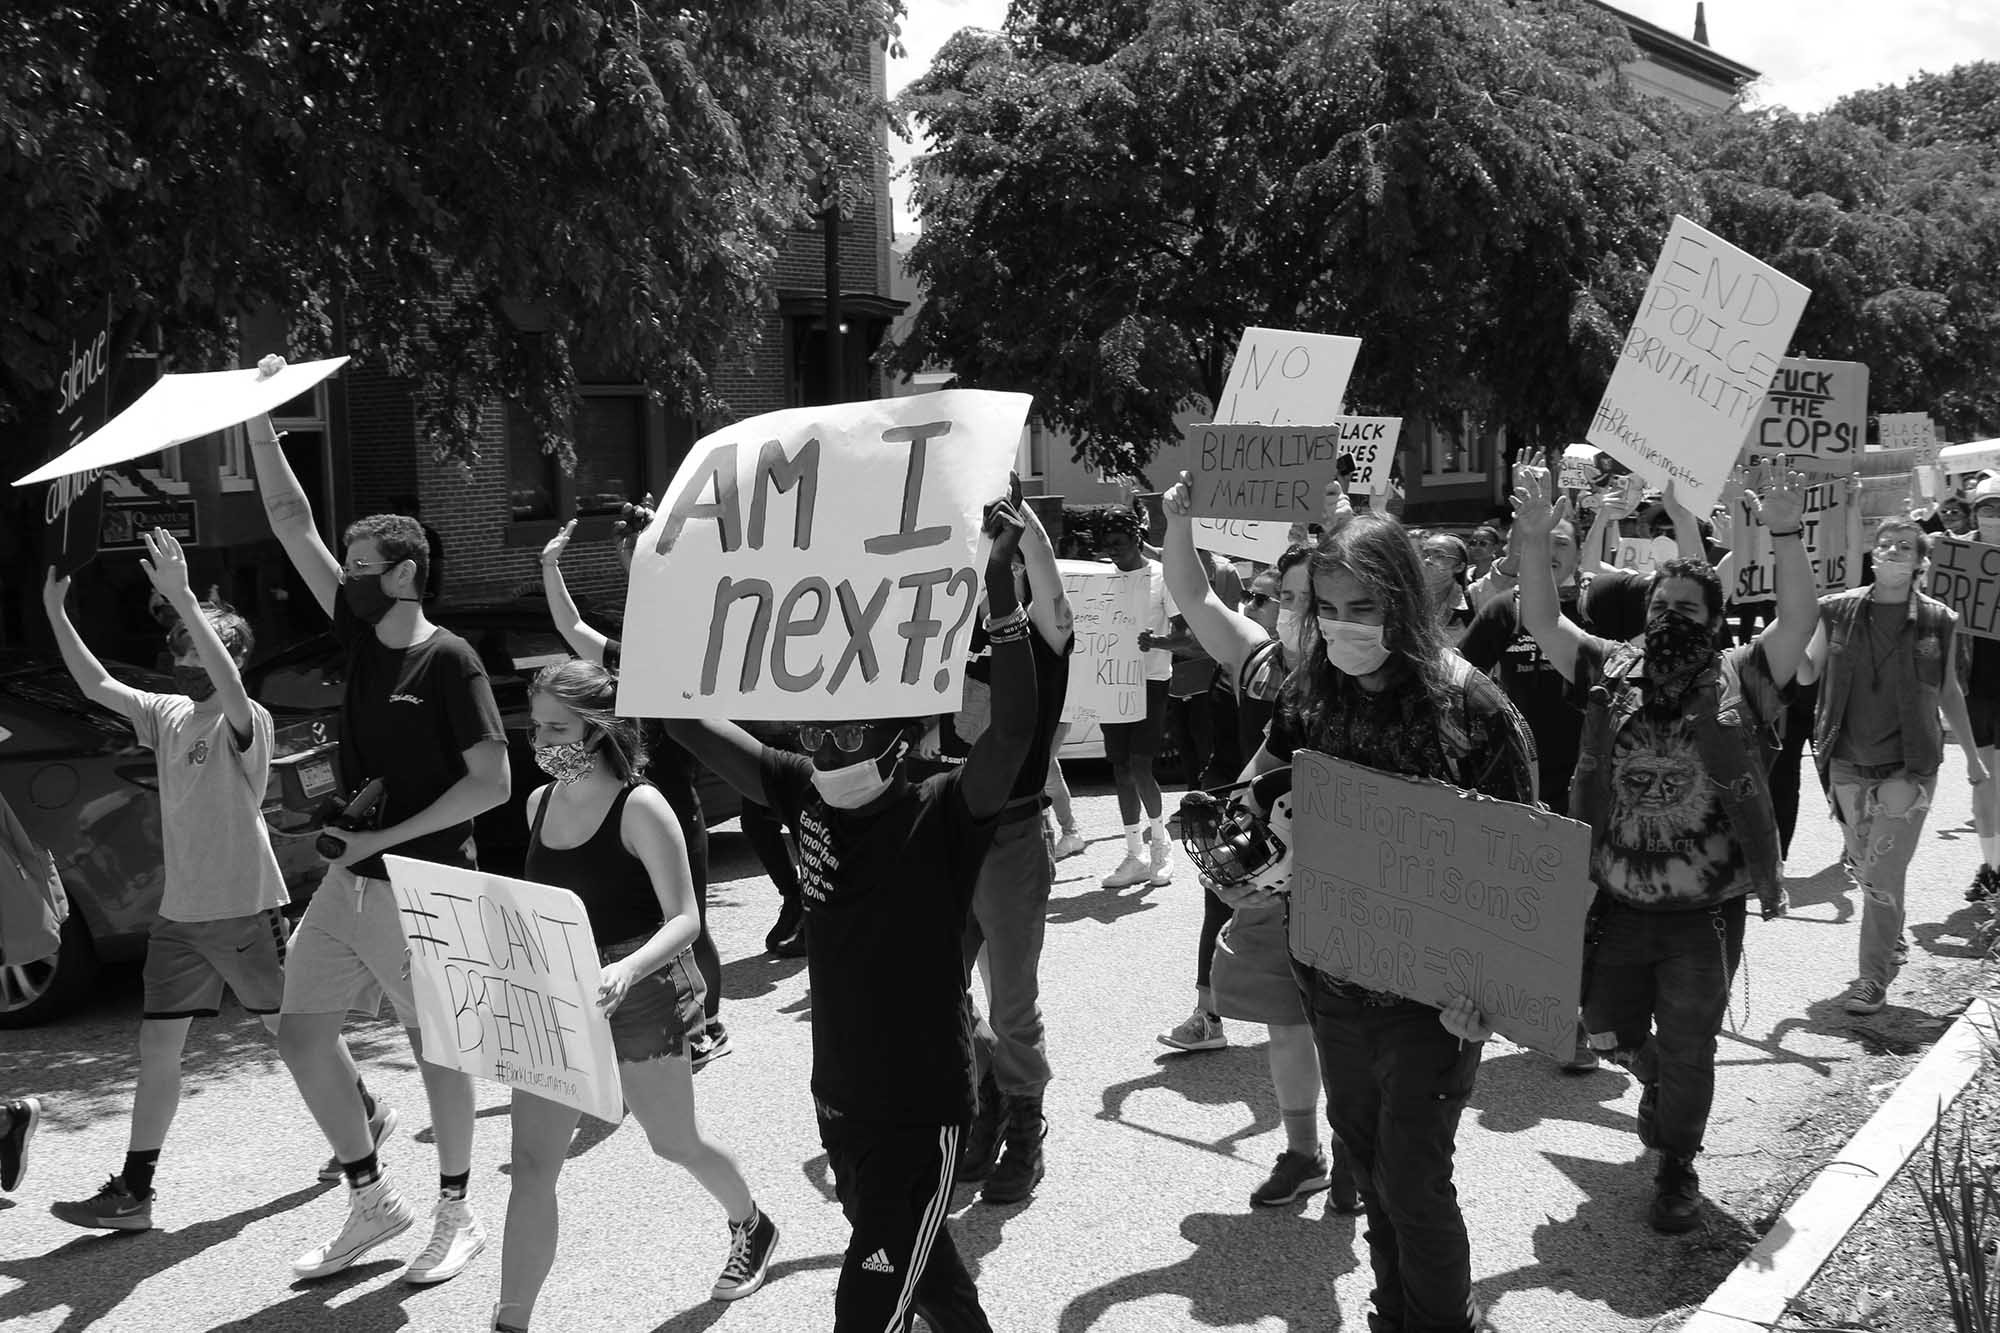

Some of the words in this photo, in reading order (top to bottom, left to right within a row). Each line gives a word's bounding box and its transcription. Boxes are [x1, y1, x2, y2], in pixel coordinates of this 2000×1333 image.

[1663, 236, 1780, 326] END
[1646, 286, 1777, 388] POLICE
[57, 330, 105, 415] silence
[1241, 344, 1310, 391] NO
[1624, 327, 1762, 428] BRUTALITY
[1769, 369, 1834, 395] FUCK
[1771, 398, 1825, 418] THE
[1335, 422, 1385, 440] LACK
[1759, 418, 1858, 454] COPS!
[656, 438, 820, 556] AM
[864, 420, 952, 555] I
[1209, 480, 1309, 511] MATTER
[1073, 630, 1119, 656] STOP
[1118, 690, 1137, 716] US
[1480, 824, 1563, 882] The
[862, 1261, 895, 1273] adidas
